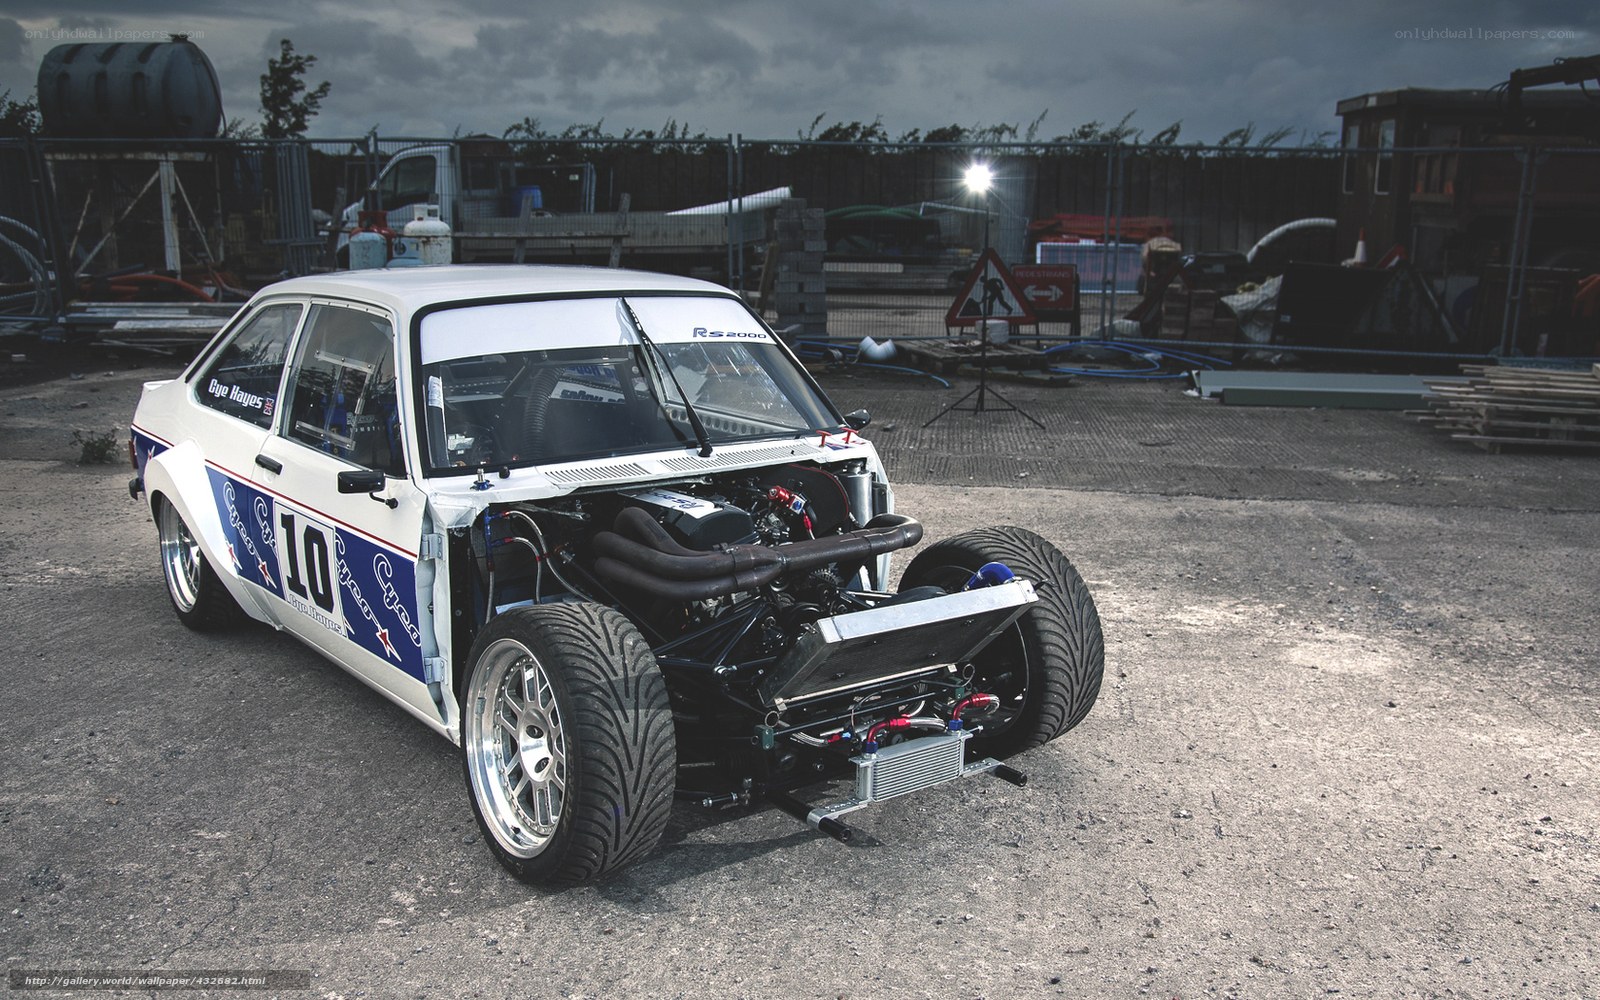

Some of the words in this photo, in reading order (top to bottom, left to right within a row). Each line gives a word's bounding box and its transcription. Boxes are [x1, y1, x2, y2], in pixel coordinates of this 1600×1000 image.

[208, 378, 229, 398] Cye
[229, 384, 264, 410] Hayes
[281, 512, 334, 614] 10
[308, 605, 343, 636] Hayes
